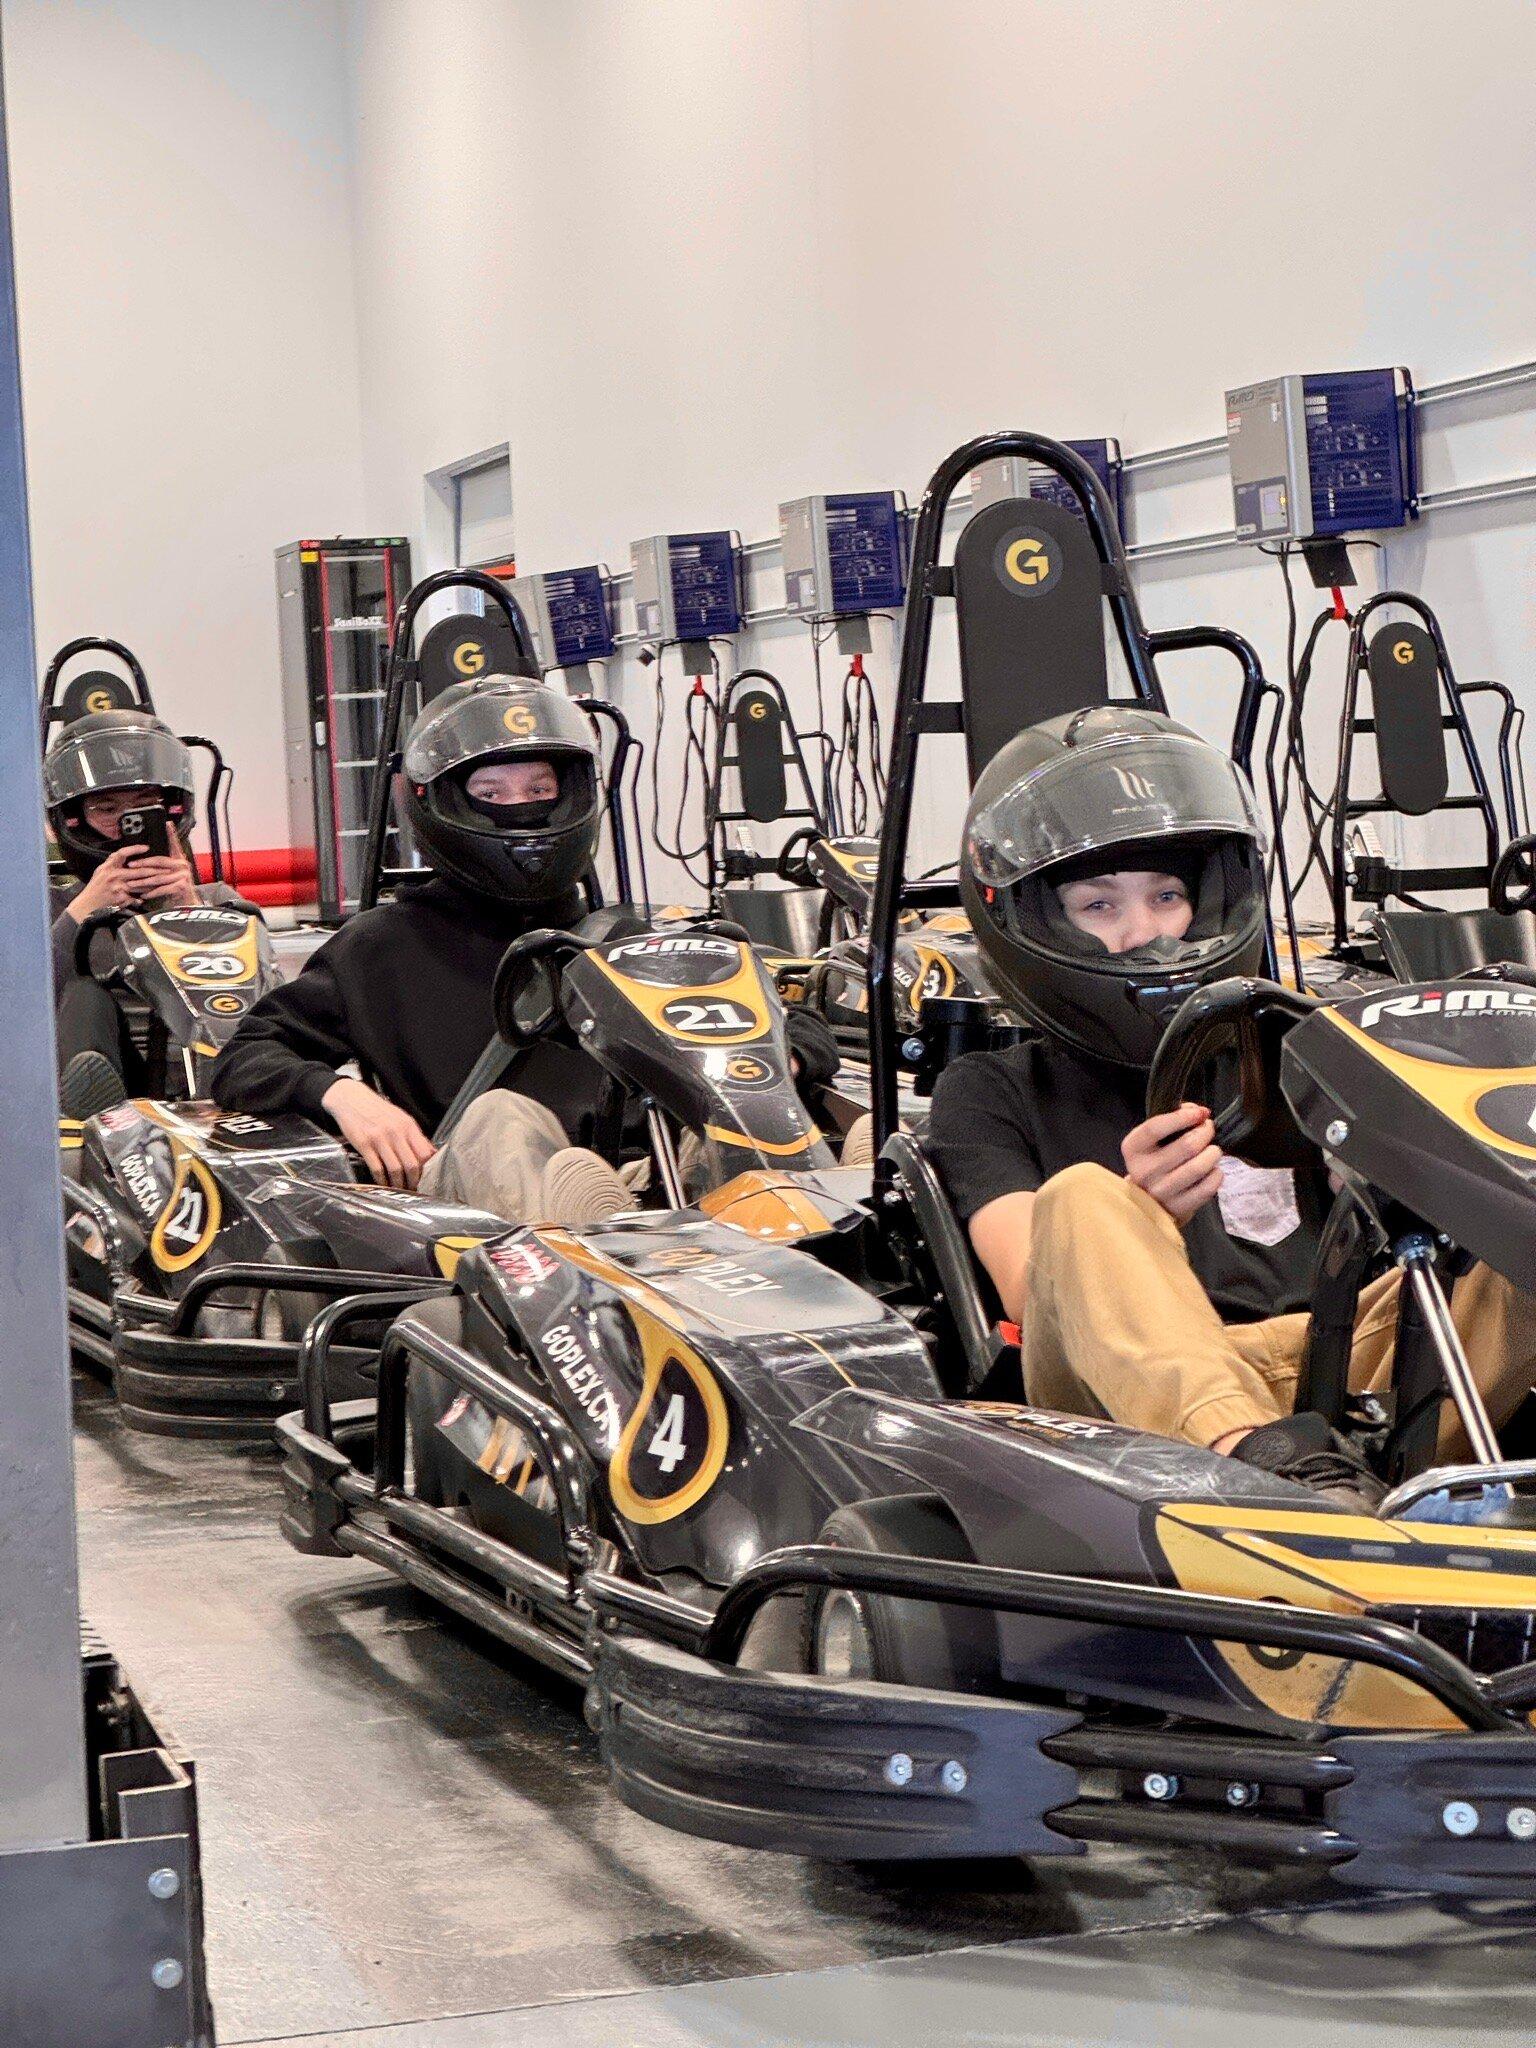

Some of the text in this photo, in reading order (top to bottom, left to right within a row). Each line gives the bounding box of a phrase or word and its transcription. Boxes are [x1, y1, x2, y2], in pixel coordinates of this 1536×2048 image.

[1005, 539, 1049, 585] G
[453, 642, 485, 674] G
[1392, 641, 1415, 665] G
[503, 705, 537, 734] G
[750, 702, 767, 719] G
[181, 956, 246, 976] 20
[922, 969, 942, 998] 3
[665, 1003, 756, 1031] 21
[726, 1059, 764, 1079] G
[647, 1394, 687, 1472] 4
